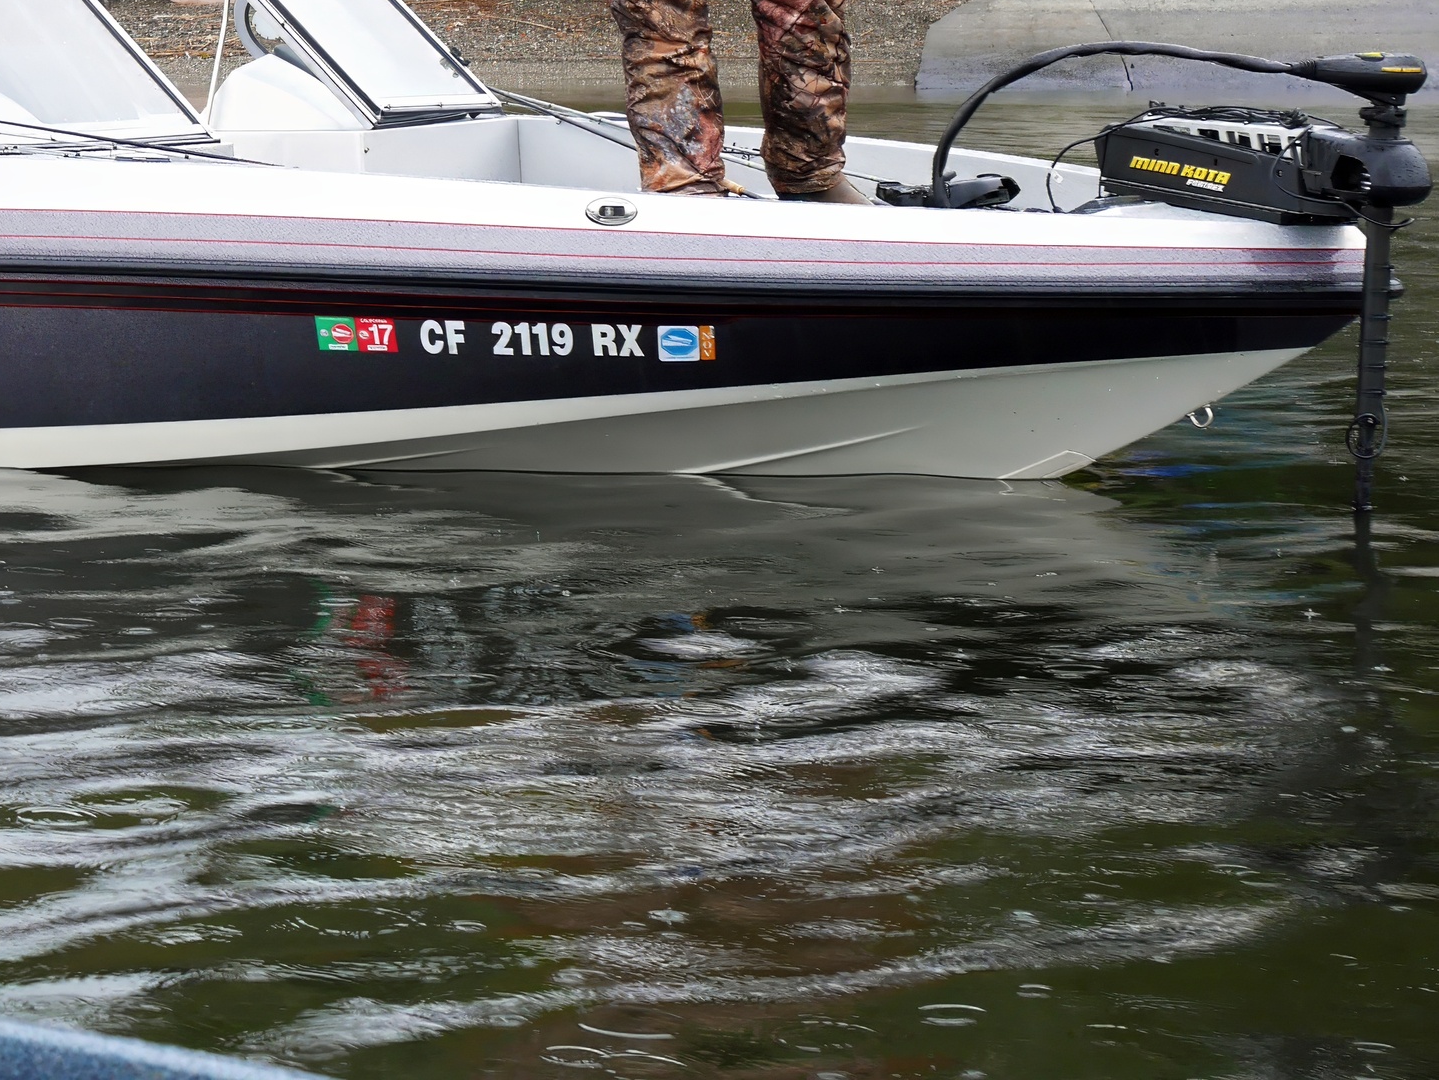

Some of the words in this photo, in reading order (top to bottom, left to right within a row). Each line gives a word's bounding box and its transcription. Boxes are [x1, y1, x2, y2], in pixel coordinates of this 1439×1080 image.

[1180, 163, 1232, 185] KOTA
[368, 323, 394, 346] 17
[419, 319, 466, 355] CF
[491, 321, 574, 356] 2119
[591, 323, 645, 357] RX
